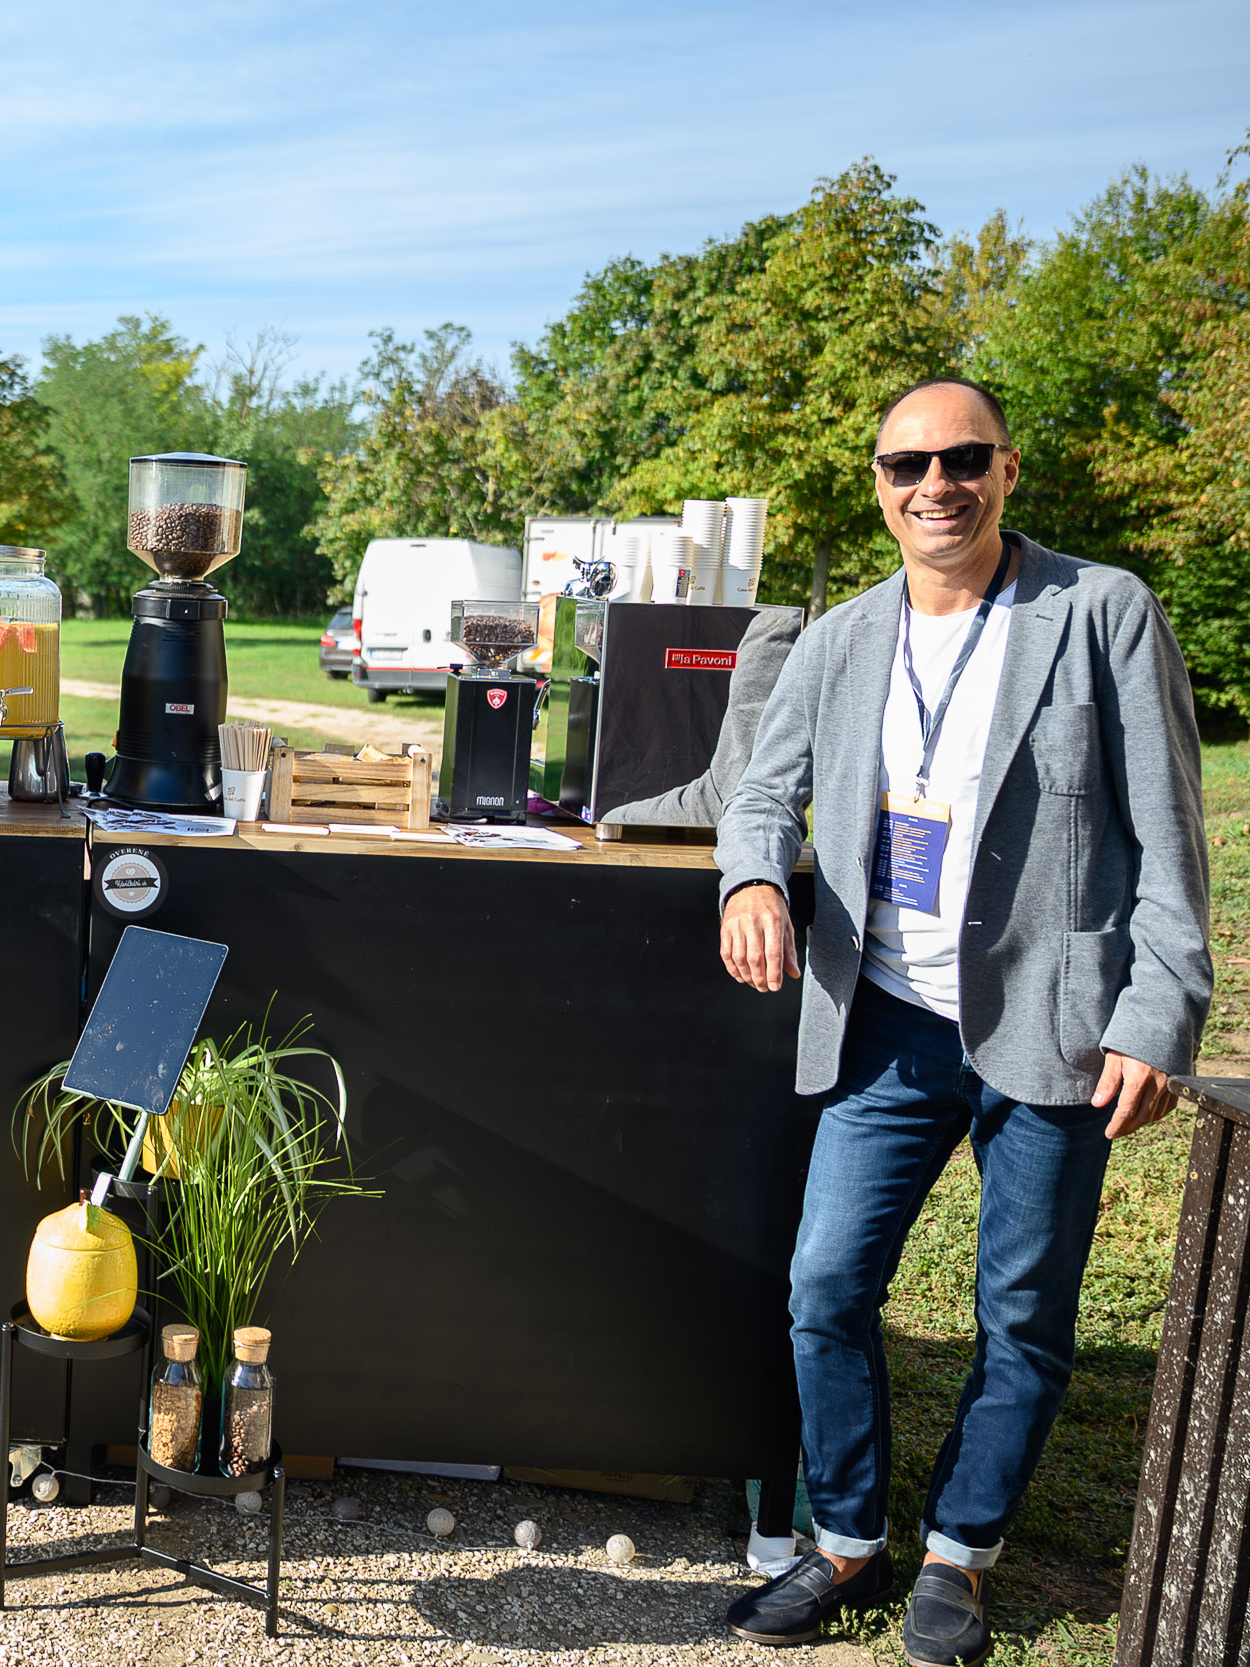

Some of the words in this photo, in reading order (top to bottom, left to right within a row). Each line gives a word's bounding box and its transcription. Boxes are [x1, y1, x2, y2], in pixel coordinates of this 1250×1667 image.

[679, 653, 690, 664] la
[692, 654, 732, 666] Pavoni
[170, 704, 191, 712] OBEL
[109, 847, 151, 860] OVERENÉ
